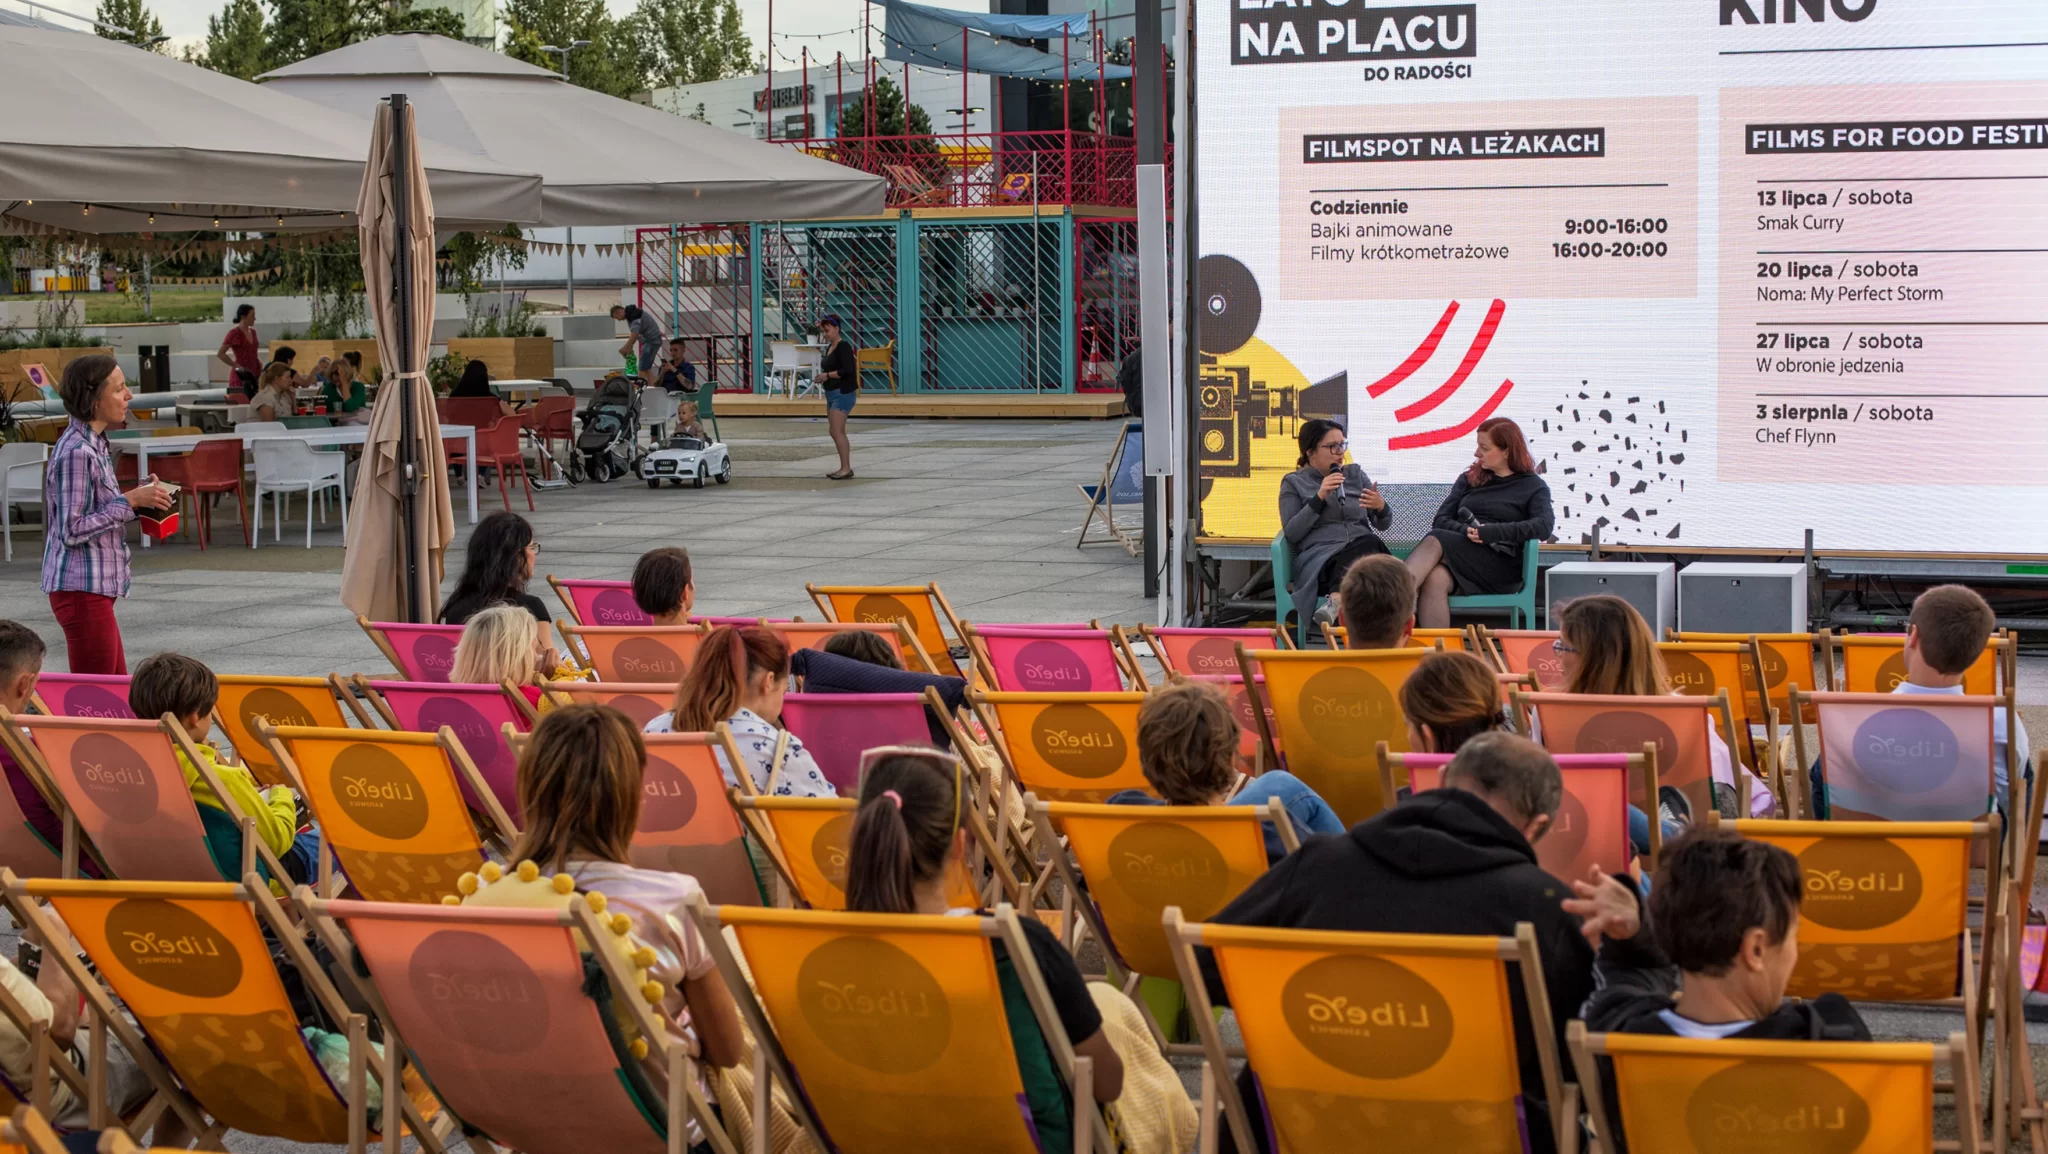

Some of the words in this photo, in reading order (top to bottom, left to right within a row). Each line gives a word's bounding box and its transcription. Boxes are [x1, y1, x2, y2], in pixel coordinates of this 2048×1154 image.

[1240, 21, 1305, 57] NA
[1318, 15, 1468, 54] PLACU
[1364, 66, 1390, 82] DO
[1394, 62, 1472, 81] RADOŚCI
[1309, 137, 1423, 158] FILMSPOT
[1430, 137, 1464, 156] NA
[1471, 132, 1600, 155] LEŻAKACH
[1752, 129, 1825, 149] FILMS
[1832, 128, 1884, 147] FOR
[1892, 126, 1964, 146] FOOD
[1972, 124, 2048, 145] FESTI
[1310, 198, 1409, 216] Codziennie
[1757, 190, 1777, 207] 13
[1782, 189, 1828, 210] lipca
[1848, 189, 1913, 206] sobota
[1311, 222, 1350, 240] Bajki
[1355, 223, 1453, 238] animowane
[1564, 217, 1668, 235] 9:00-16:00
[1757, 213, 1799, 231] Smak
[1802, 214, 1845, 234] Curry
[1311, 244, 1355, 264] Filmy
[1361, 243, 1510, 261] krótkometrażowe
[1552, 241, 1668, 259] 16:00-20:00
[1756, 262, 1782, 278] 20
[1787, 261, 1833, 281] lipca
[1853, 260, 1919, 278] sobota
[1757, 286, 1807, 302] Noma:
[1810, 286, 1835, 305] My
[1838, 284, 1894, 302] Perfect
[1897, 285, 1944, 301] Storm
[1756, 332, 1780, 349] 27
[1784, 332, 1830, 352] lipca
[1858, 332, 1923, 349] sobota
[1756, 357, 1772, 373] W
[1775, 356, 1836, 373] obronie
[1838, 357, 1904, 377] jedzenia
[1756, 404, 1768, 420] 3
[1772, 403, 1848, 423] sierpnia
[1869, 404, 1934, 422] sobota
[1755, 427, 1792, 444] Chef
[1794, 427, 1836, 448] Flynn
